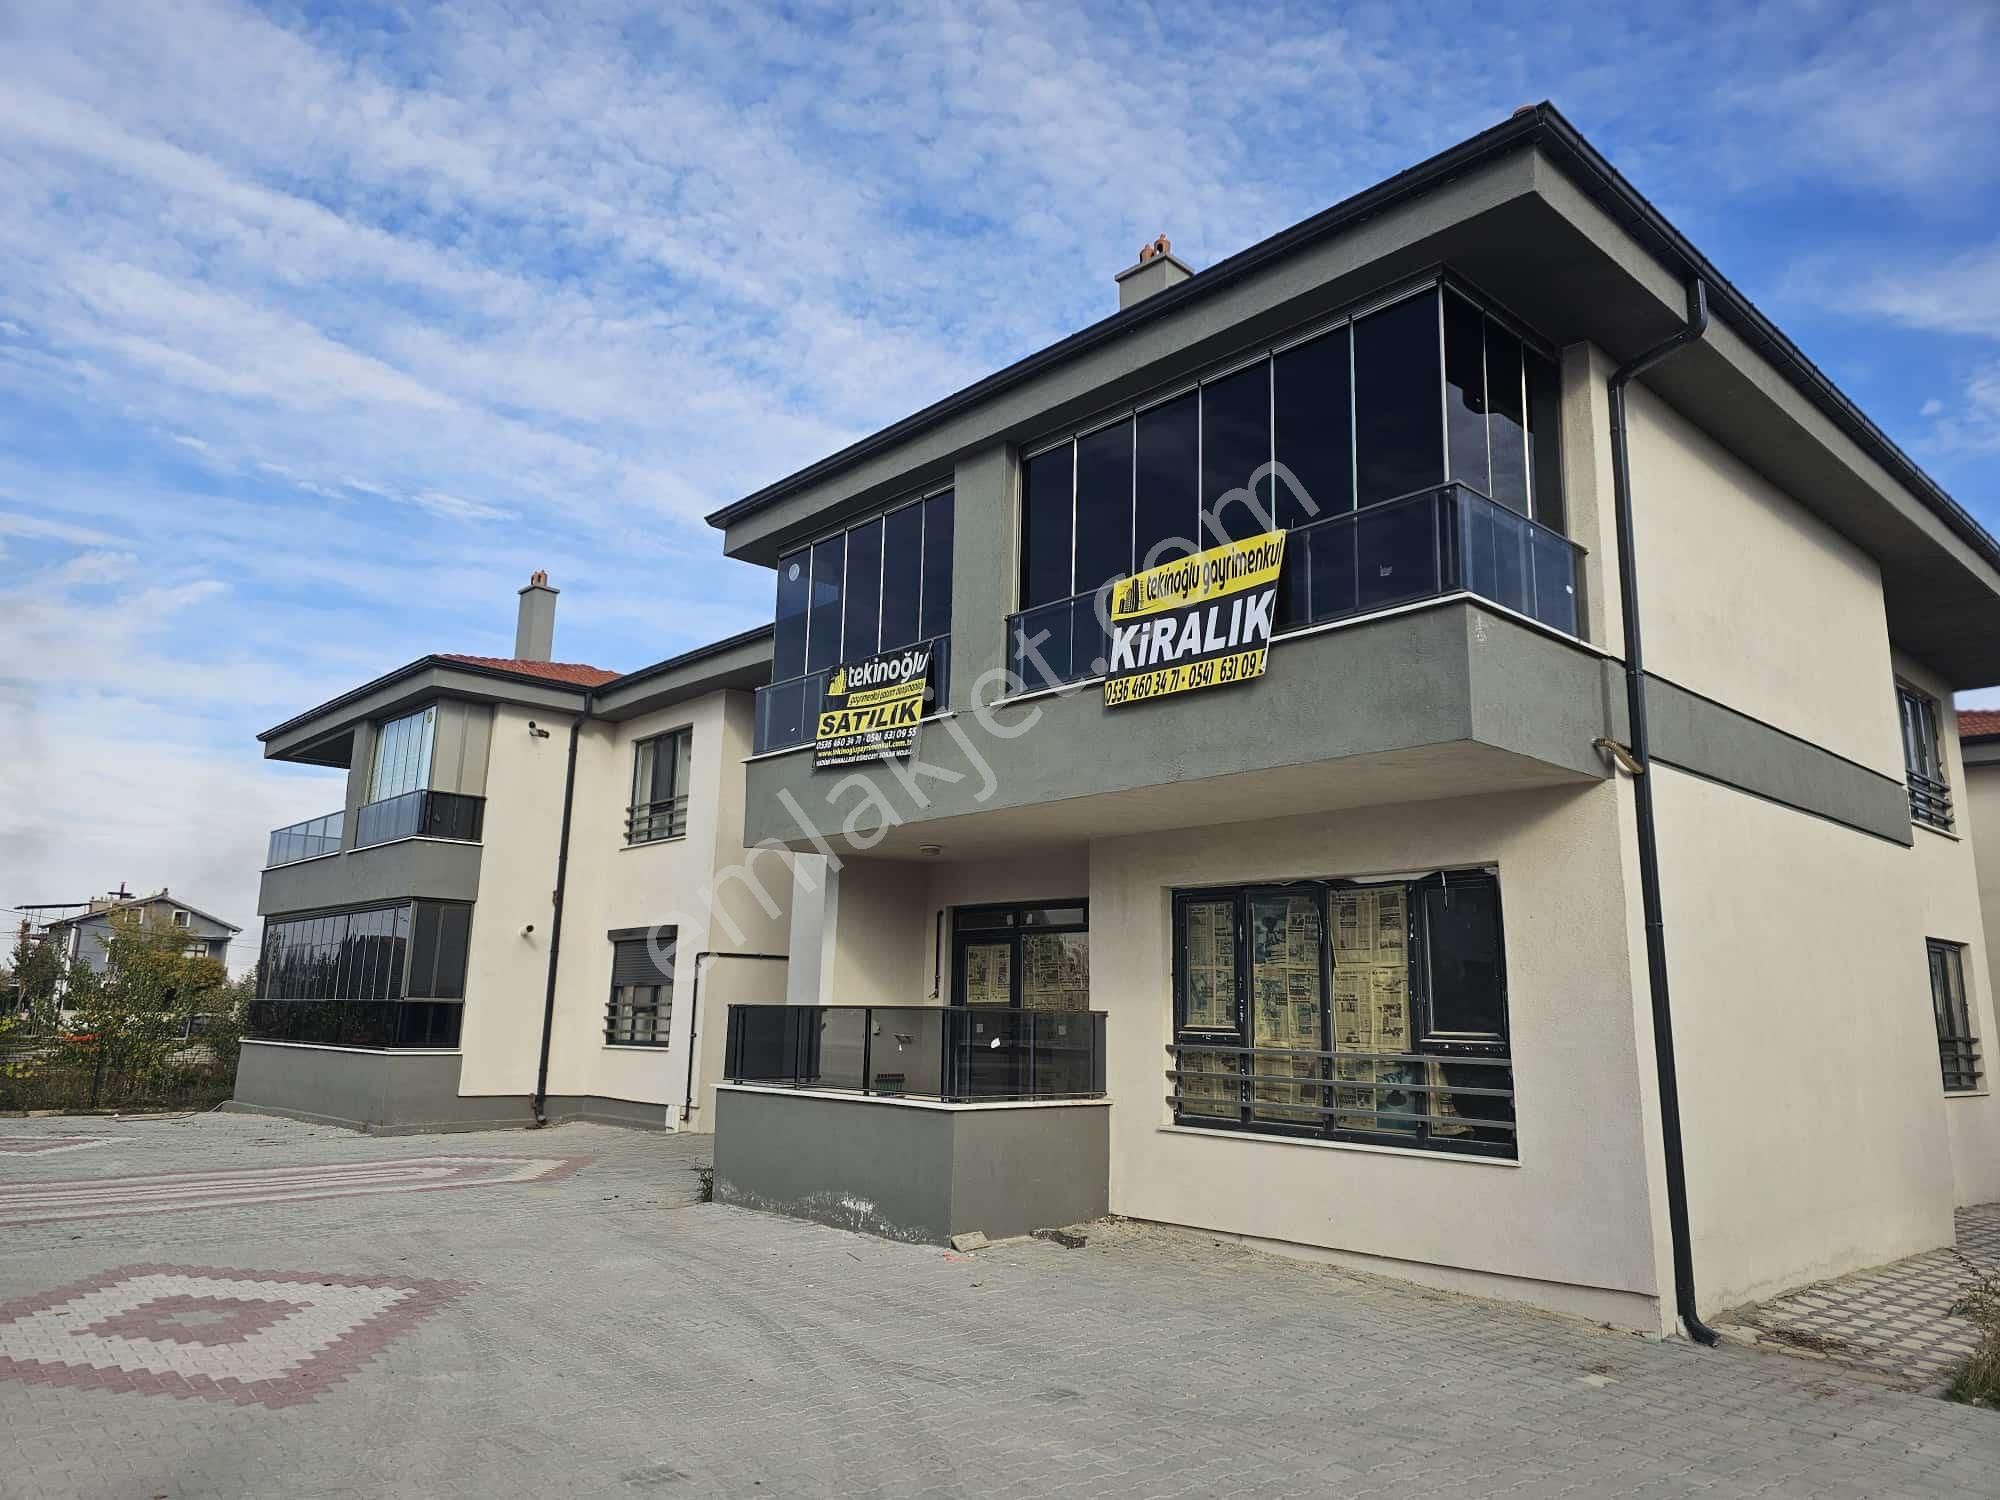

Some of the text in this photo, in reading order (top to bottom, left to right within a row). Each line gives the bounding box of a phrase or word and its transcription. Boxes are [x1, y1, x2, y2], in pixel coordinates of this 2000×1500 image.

[1146, 562, 1200, 601] tekinoğlu
[1203, 537, 1284, 595] gayrimenkul
[847, 651, 929, 688] tekinoğlu
[1106, 678, 1129, 704] 0536
[1132, 675, 1152, 698] 460
[1153, 671, 1167, 694] 34
[1169, 668, 1180, 691] 71
[1188, 661, 1215, 688] 0541
[1219, 657, 1238, 682] 631
[1241, 652, 1257, 677] 09
[820, 699, 920, 736] SATILIK
